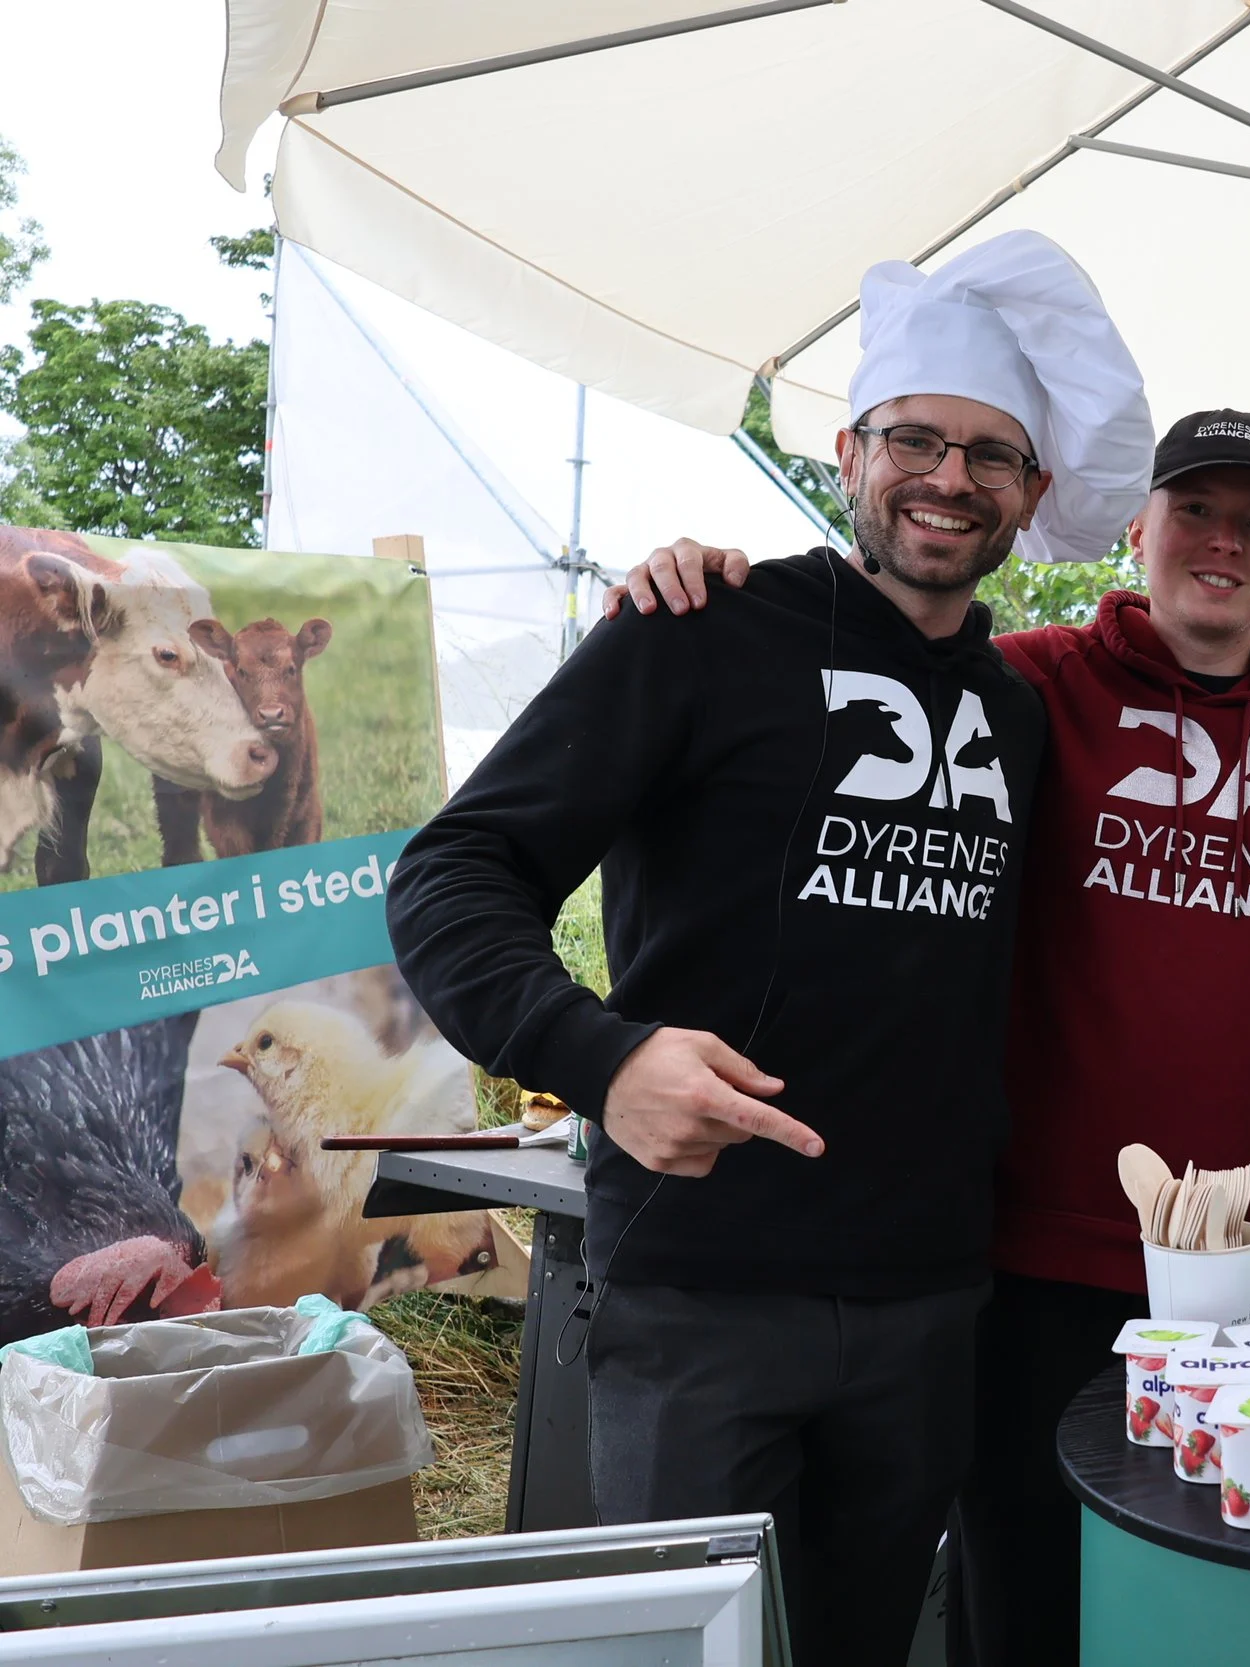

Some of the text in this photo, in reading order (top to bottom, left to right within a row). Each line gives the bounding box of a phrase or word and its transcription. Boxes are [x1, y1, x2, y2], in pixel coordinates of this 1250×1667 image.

[1198, 421, 1250, 433] DYRENES
[817, 814, 1009, 877] DYRENES
[797, 864, 995, 921] ALLIANCE
[30, 889, 240, 977] planter
[251, 875, 267, 919] i
[139, 957, 212, 985] DYRENES
[140, 974, 215, 1000] ALLIANCE
[1231, 1316, 1247, 1326] new
